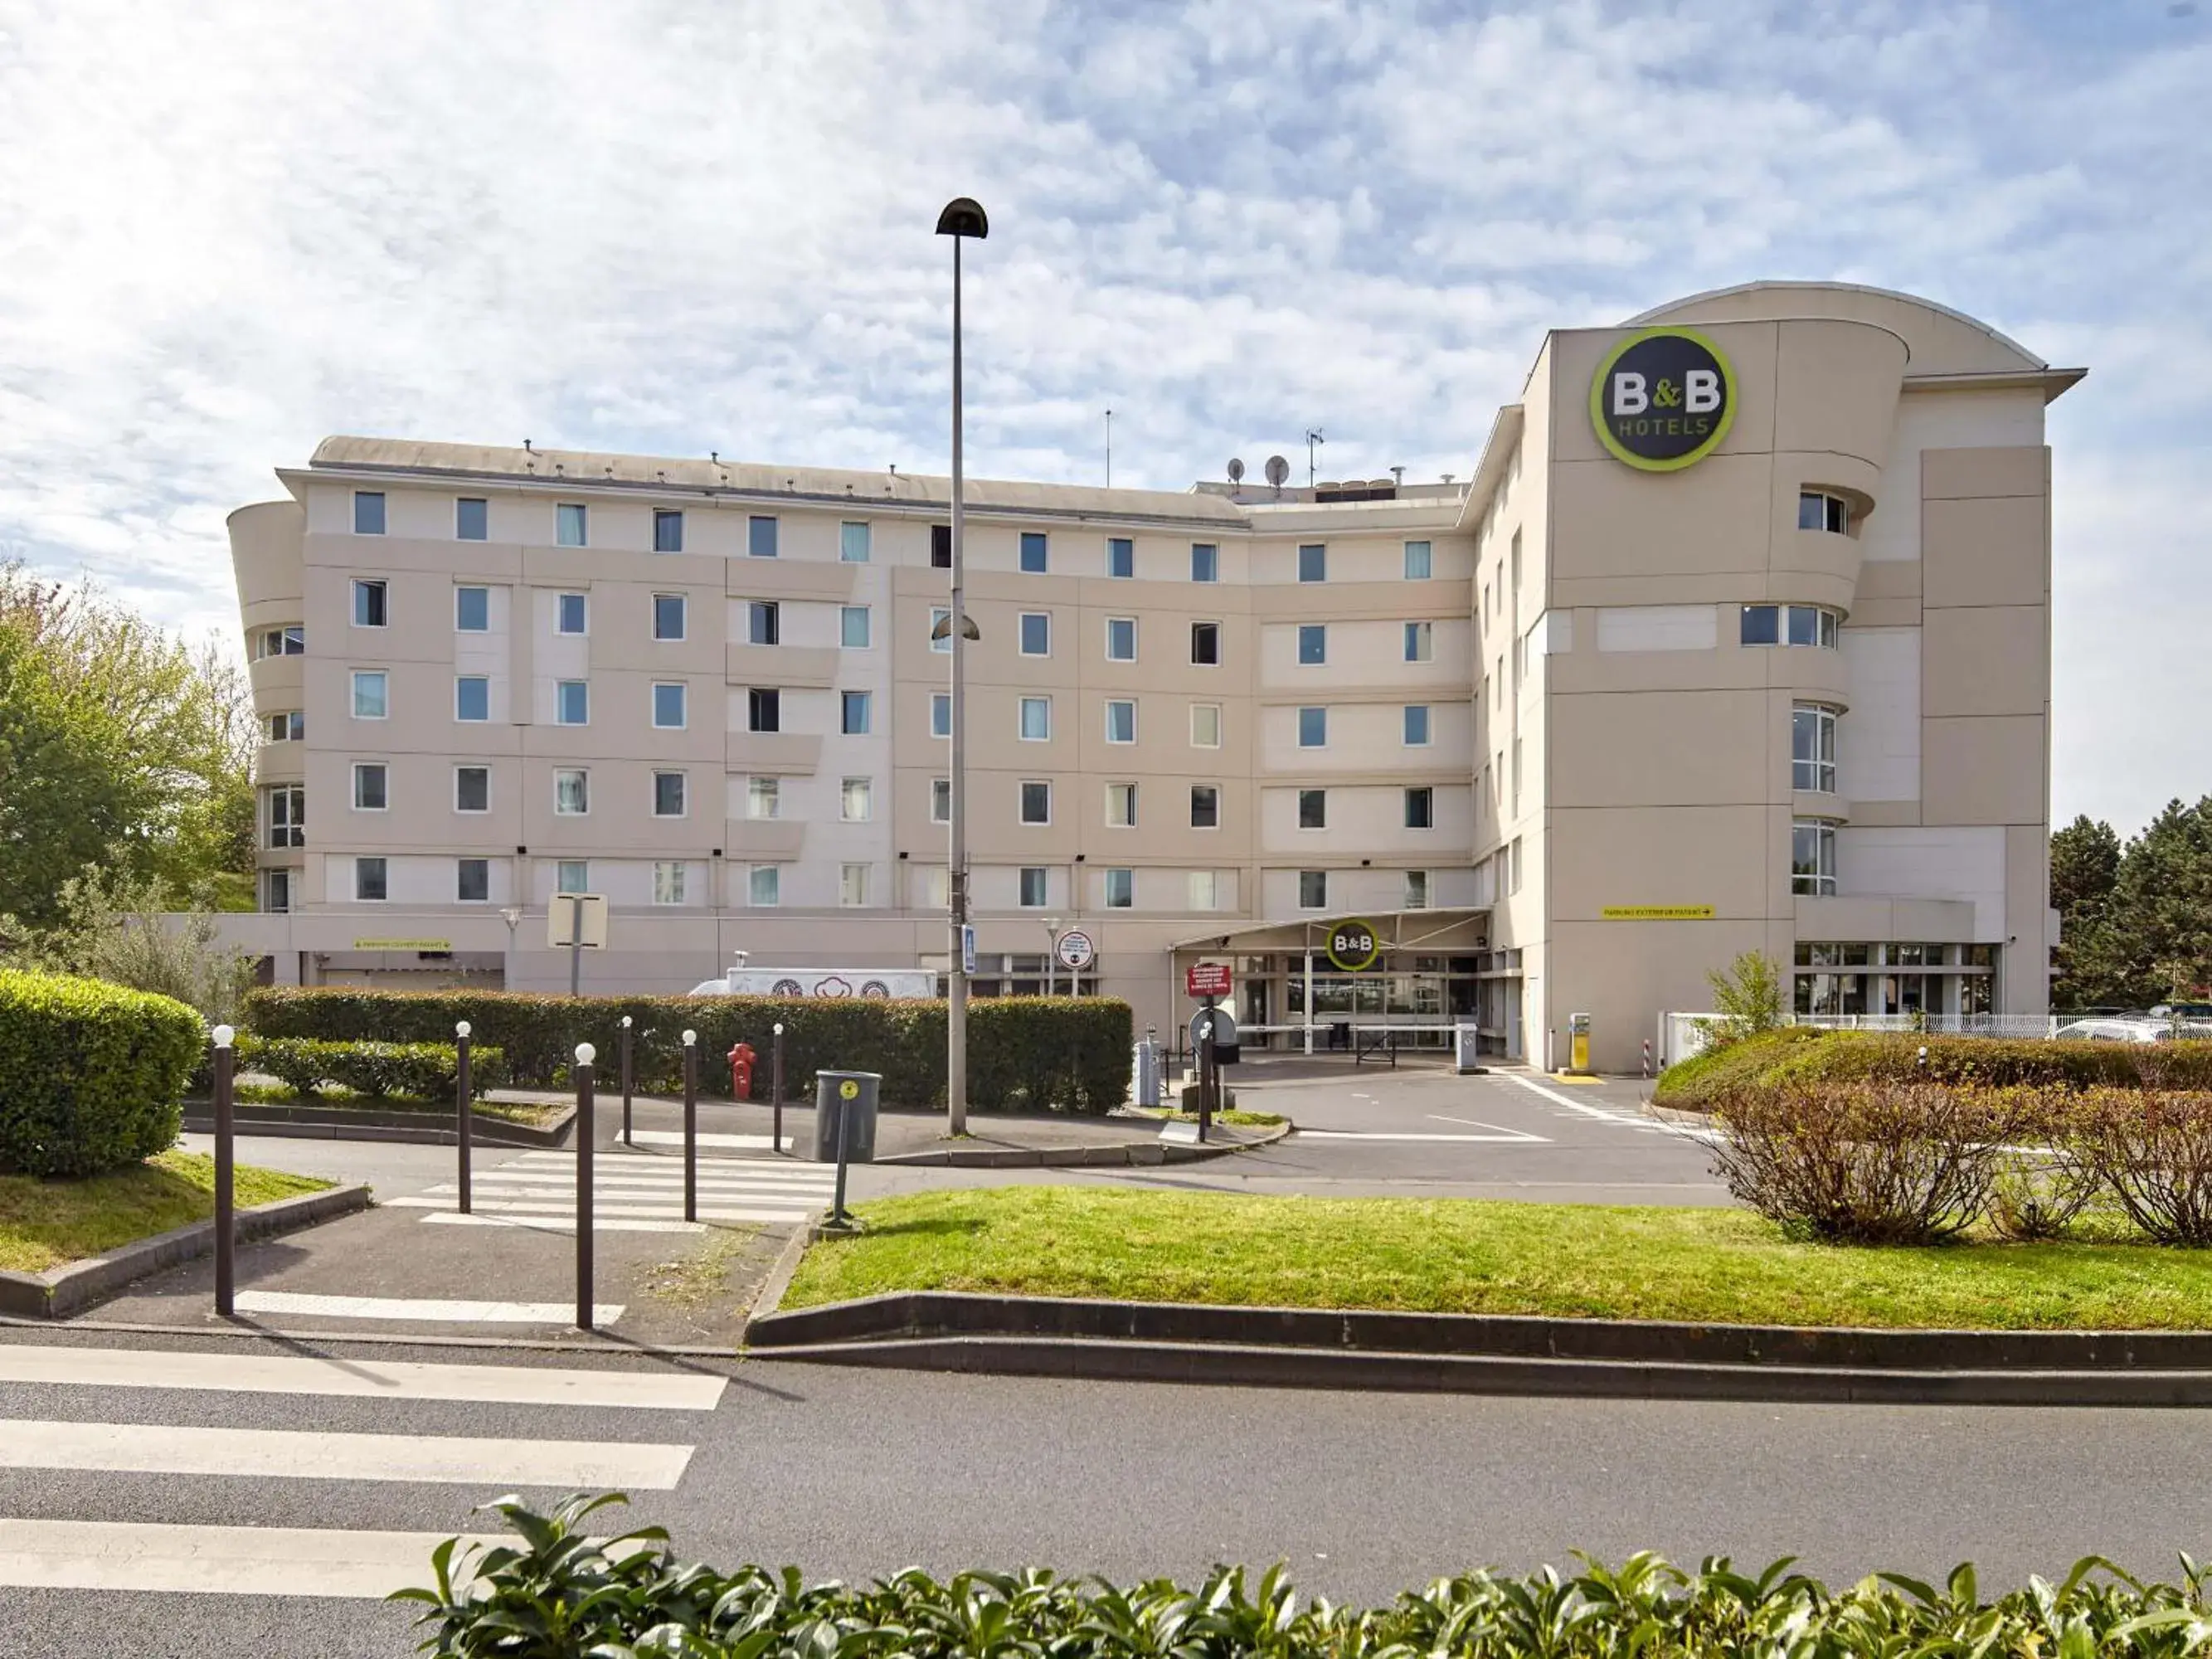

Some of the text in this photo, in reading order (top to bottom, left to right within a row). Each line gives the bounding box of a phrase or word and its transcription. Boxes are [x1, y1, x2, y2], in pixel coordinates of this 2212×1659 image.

[1613, 369, 1721, 416] B&B
[1619, 418, 1709, 436] HOTELS
[1334, 935, 1373, 951] B&B
